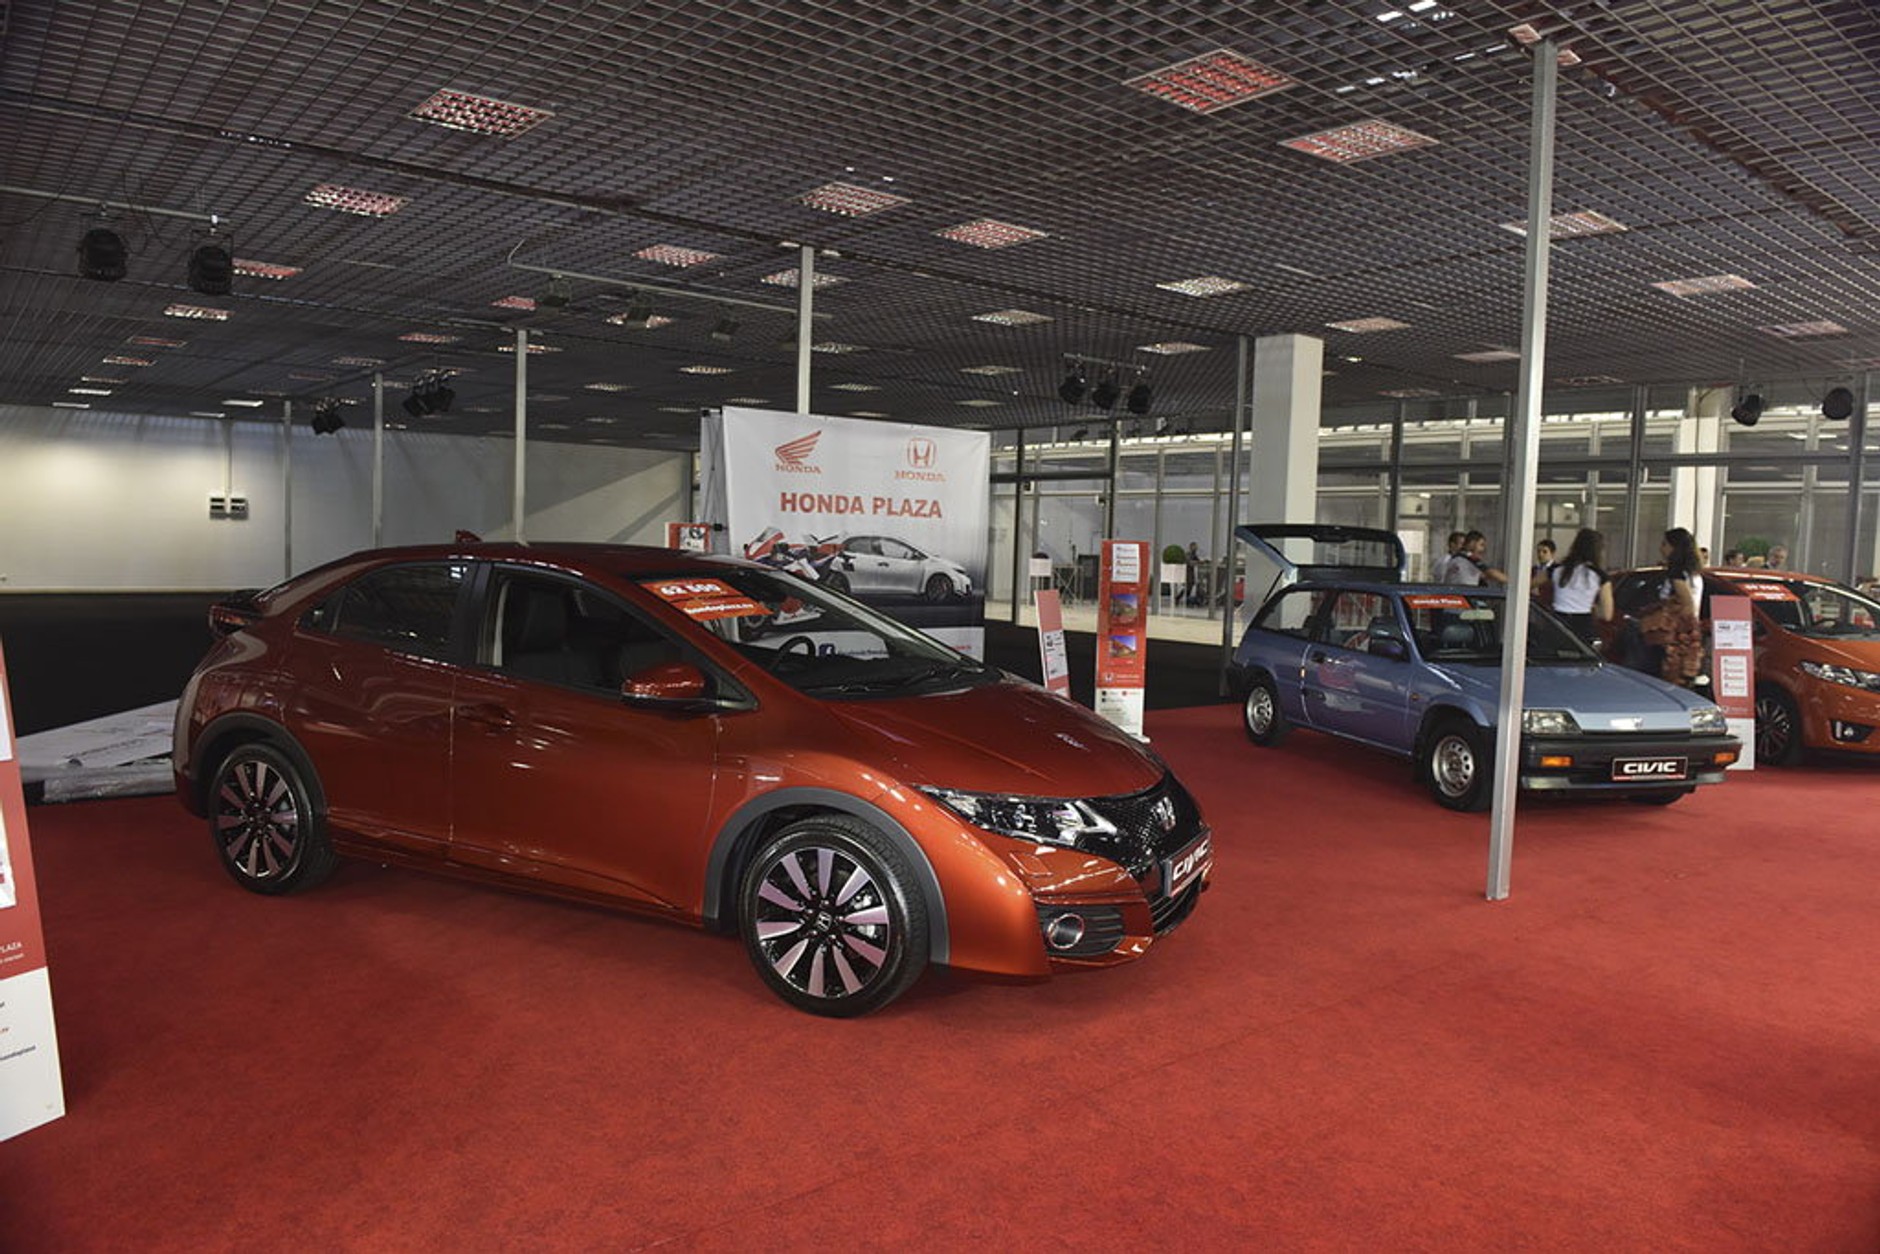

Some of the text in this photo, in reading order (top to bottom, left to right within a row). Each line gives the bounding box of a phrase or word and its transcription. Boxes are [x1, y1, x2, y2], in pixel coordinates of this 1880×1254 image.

[775, 463, 821, 474] HONDA
[894, 470, 945, 482] HONDA
[780, 491, 942, 519] HONDA PLAZA
[1623, 761, 1677, 774] CIVIC
[1173, 839, 1209, 881] CIVIC
